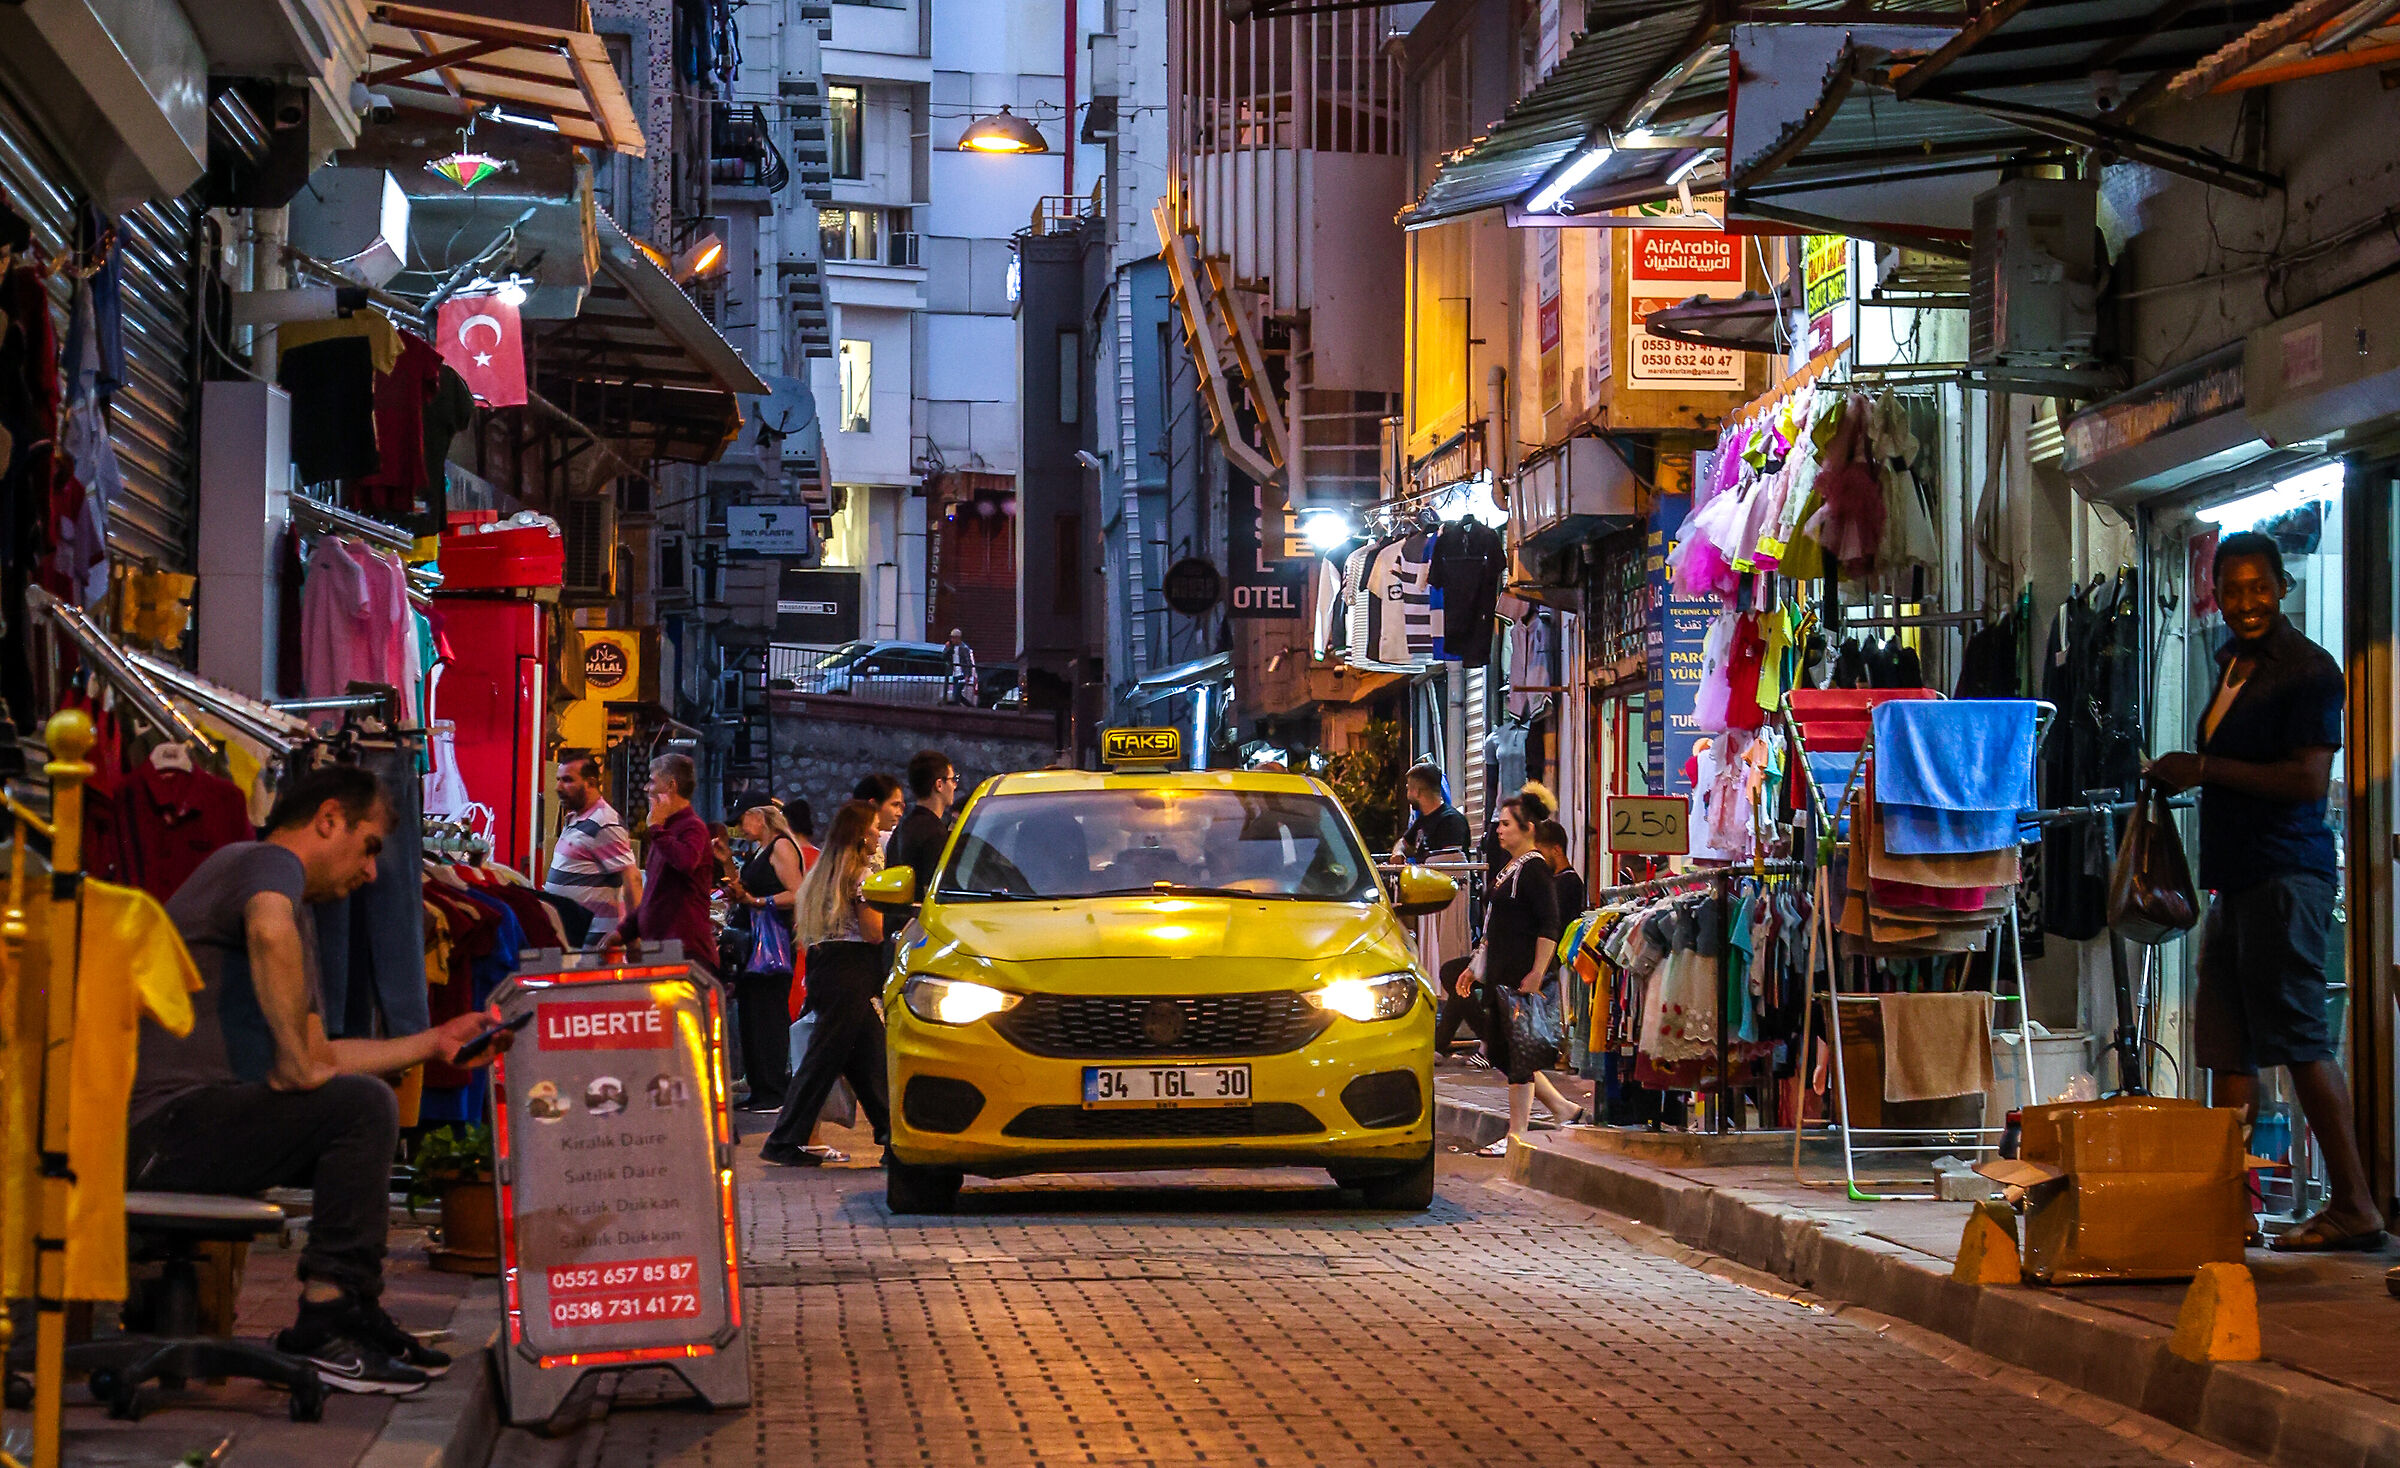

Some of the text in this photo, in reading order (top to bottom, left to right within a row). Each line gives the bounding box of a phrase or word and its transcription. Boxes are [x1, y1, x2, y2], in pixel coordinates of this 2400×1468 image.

[1644, 239, 1730, 255] AirArabia
[1644, 255, 1730, 272] العربية للطيران
[1642, 340, 1671, 351] 0553
[1642, 355, 1732, 367] 0530 632 40 47
[1233, 586, 1295, 609] OTEL
[586, 662, 623, 672] HALAL
[1670, 714, 1700, 728] TUR
[1614, 810, 1677, 837] 250
[548, 1003, 663, 1040] LIBERTÉ
[1099, 1069, 1246, 1098] 34 TGL 30
[552, 1262, 693, 1289] 0552 657 85 87
[608, 1298, 641, 1317] 731
[646, 1297, 667, 1314] 41
[671, 1294, 696, 1312] 72
